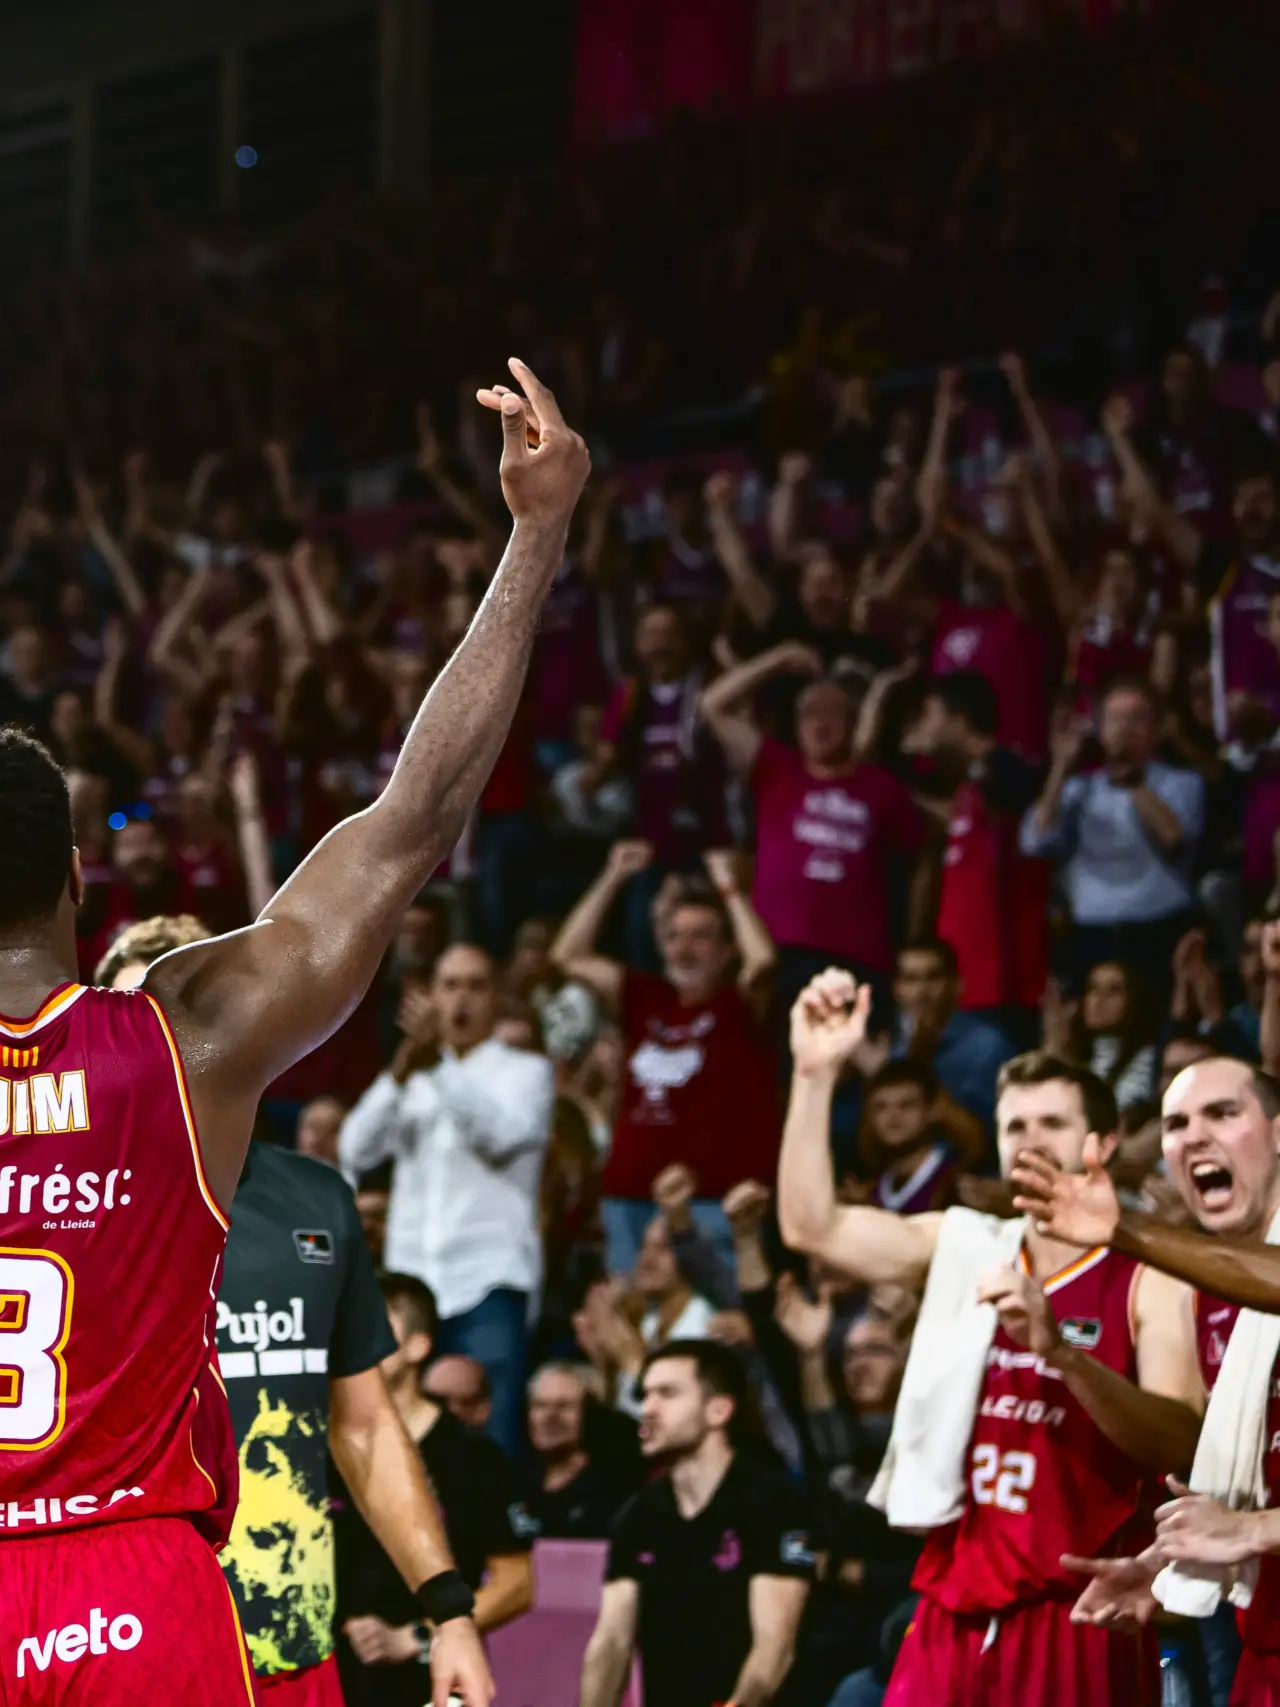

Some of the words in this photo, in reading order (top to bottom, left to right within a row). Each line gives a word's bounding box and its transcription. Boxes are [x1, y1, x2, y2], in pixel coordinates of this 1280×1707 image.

[42, 1219, 57, 1230] de
[60, 1219, 96, 1230] Lleida
[216, 1297, 306, 1351] Pujol
[972, 1443, 1037, 1515] 22
